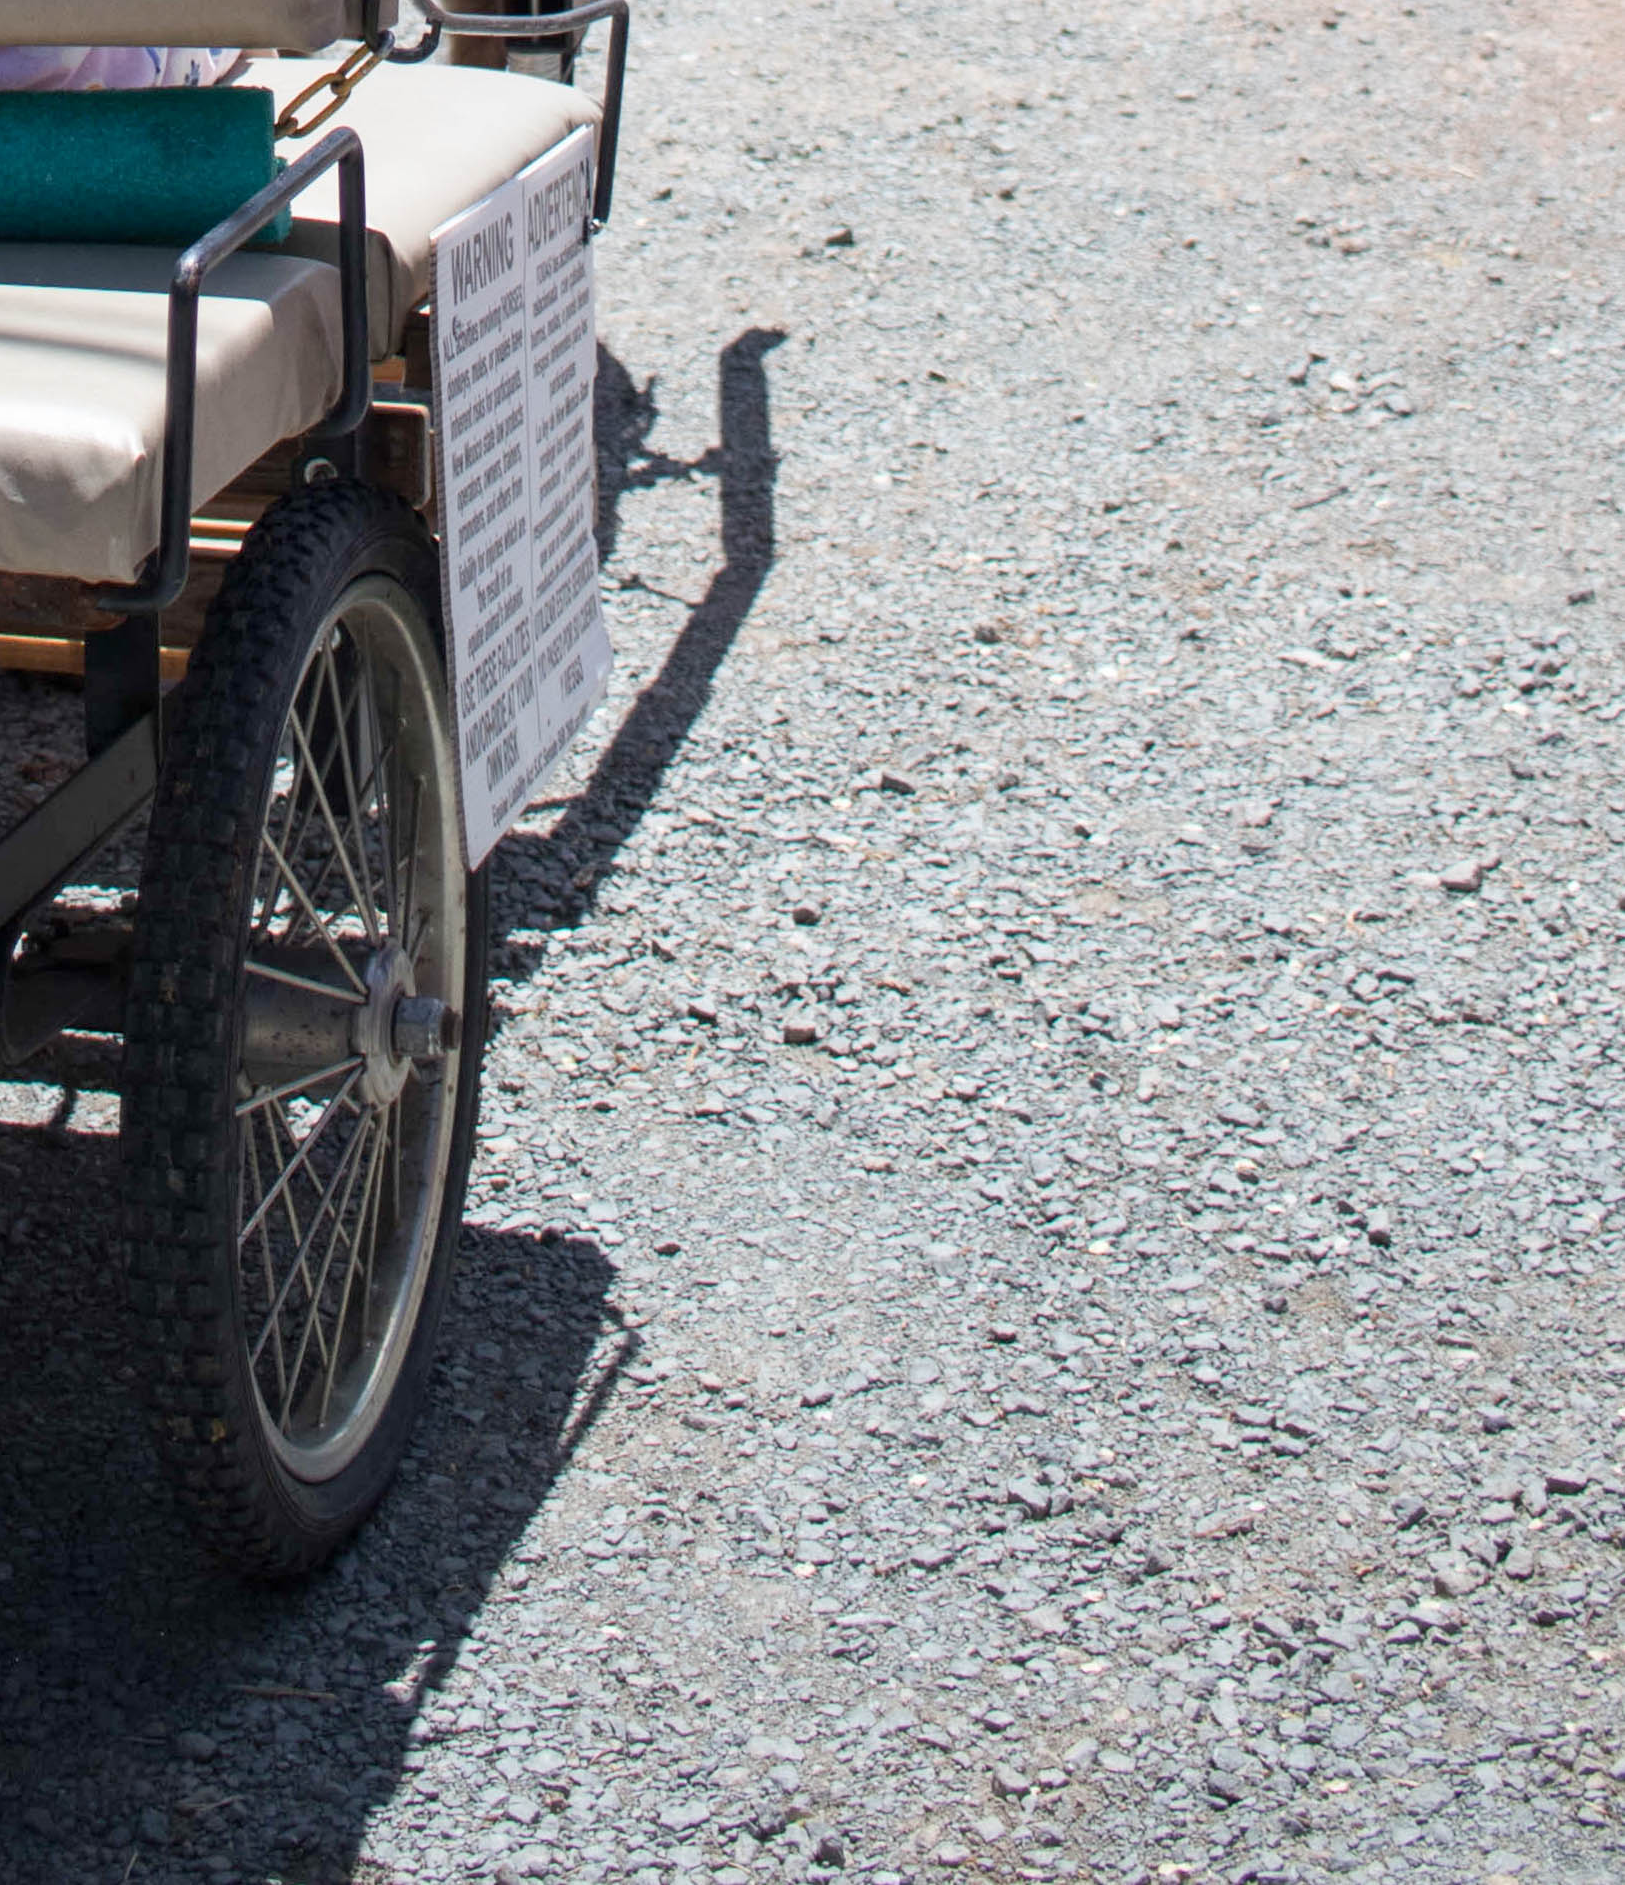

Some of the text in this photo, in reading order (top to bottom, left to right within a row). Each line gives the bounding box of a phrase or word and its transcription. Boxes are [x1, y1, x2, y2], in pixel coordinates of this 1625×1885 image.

[451, 212, 514, 306] WARNING
[461, 616, 530, 719] USE THESE FACILITIES
[516, 664, 534, 709] YOUR
[487, 729, 519, 791] OWN RISK
